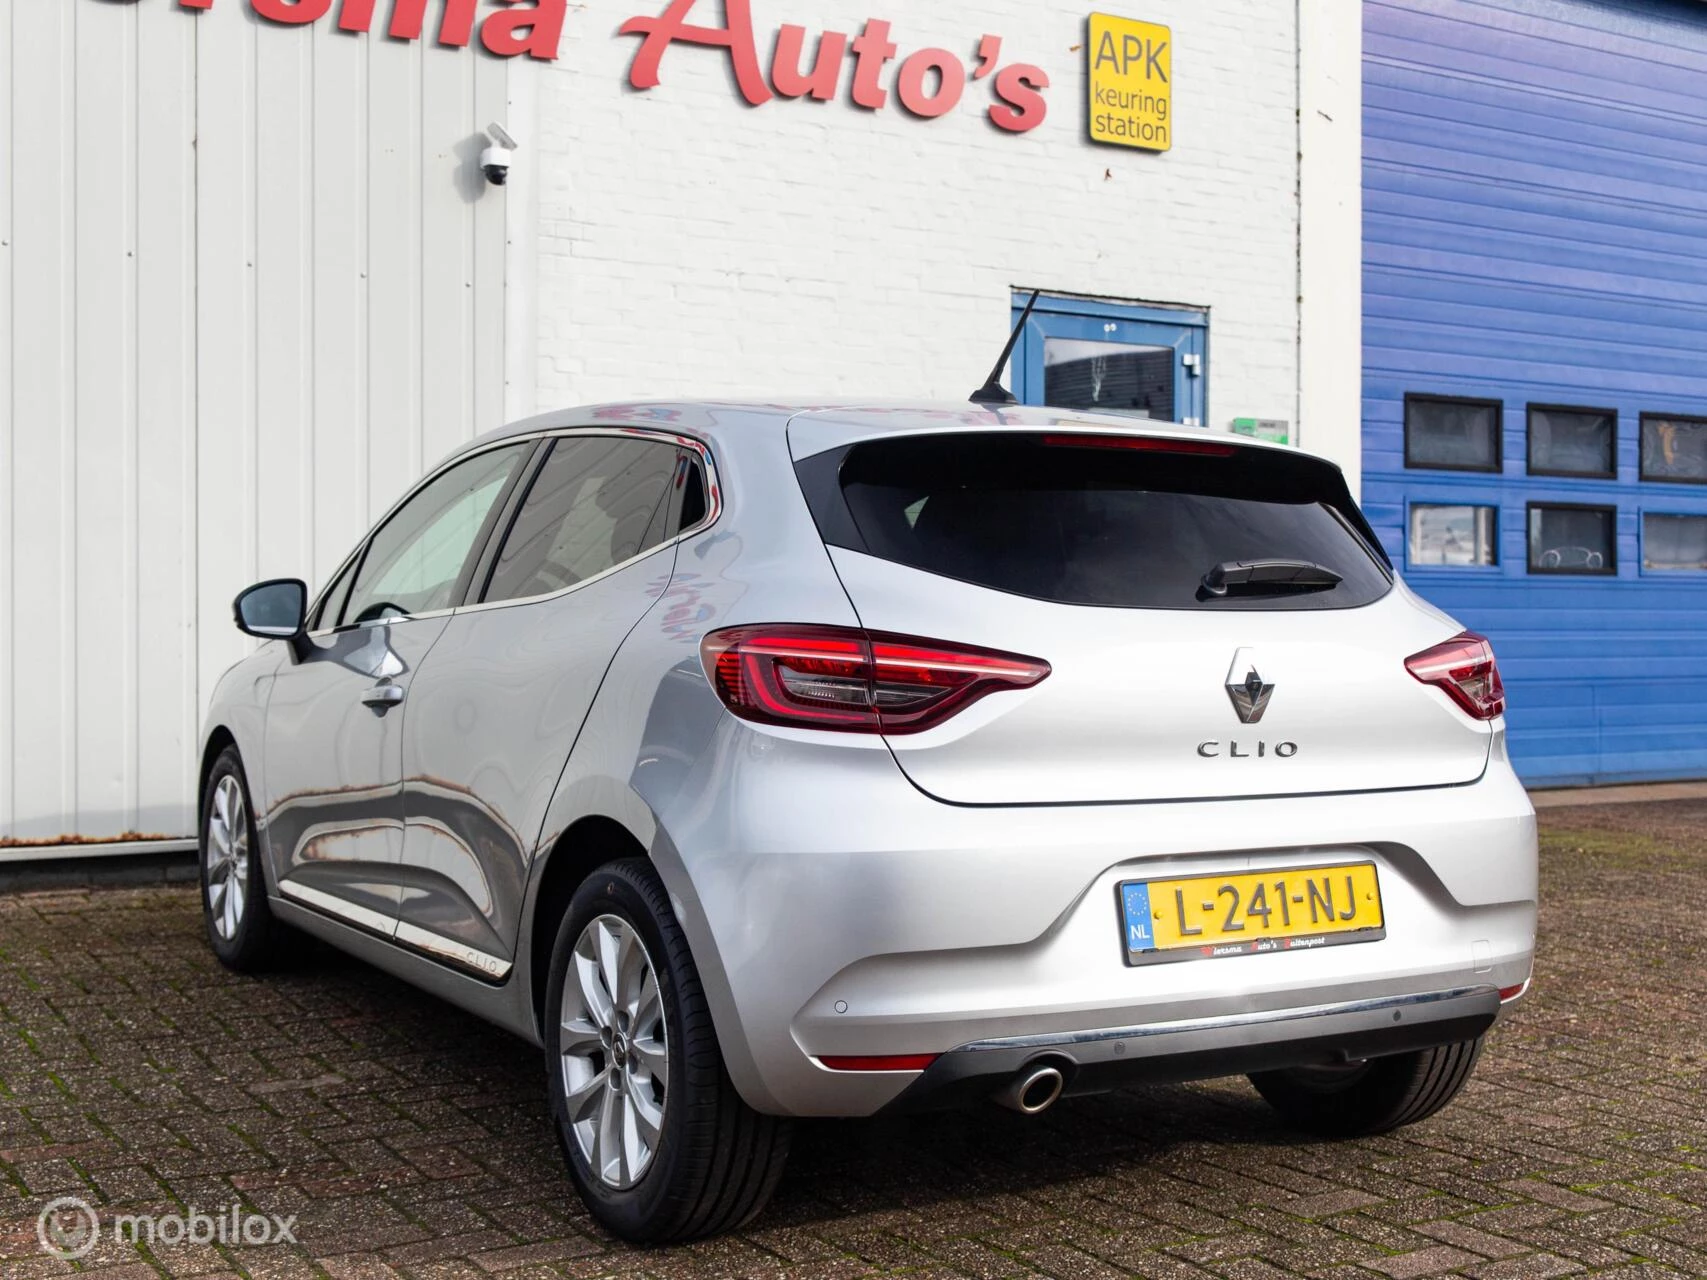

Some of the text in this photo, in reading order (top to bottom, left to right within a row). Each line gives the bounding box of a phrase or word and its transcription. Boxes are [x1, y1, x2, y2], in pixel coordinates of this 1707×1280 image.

[618, 0, 1050, 133] Auto's
[1095, 30, 1168, 83] APK
[1095, 80, 1167, 121] keuring
[1095, 112, 1167, 143] station
[1197, 740, 1298, 758] CLIO
[1175, 875, 1356, 936] L-241-NJ
[1130, 924, 1150, 940] NL
